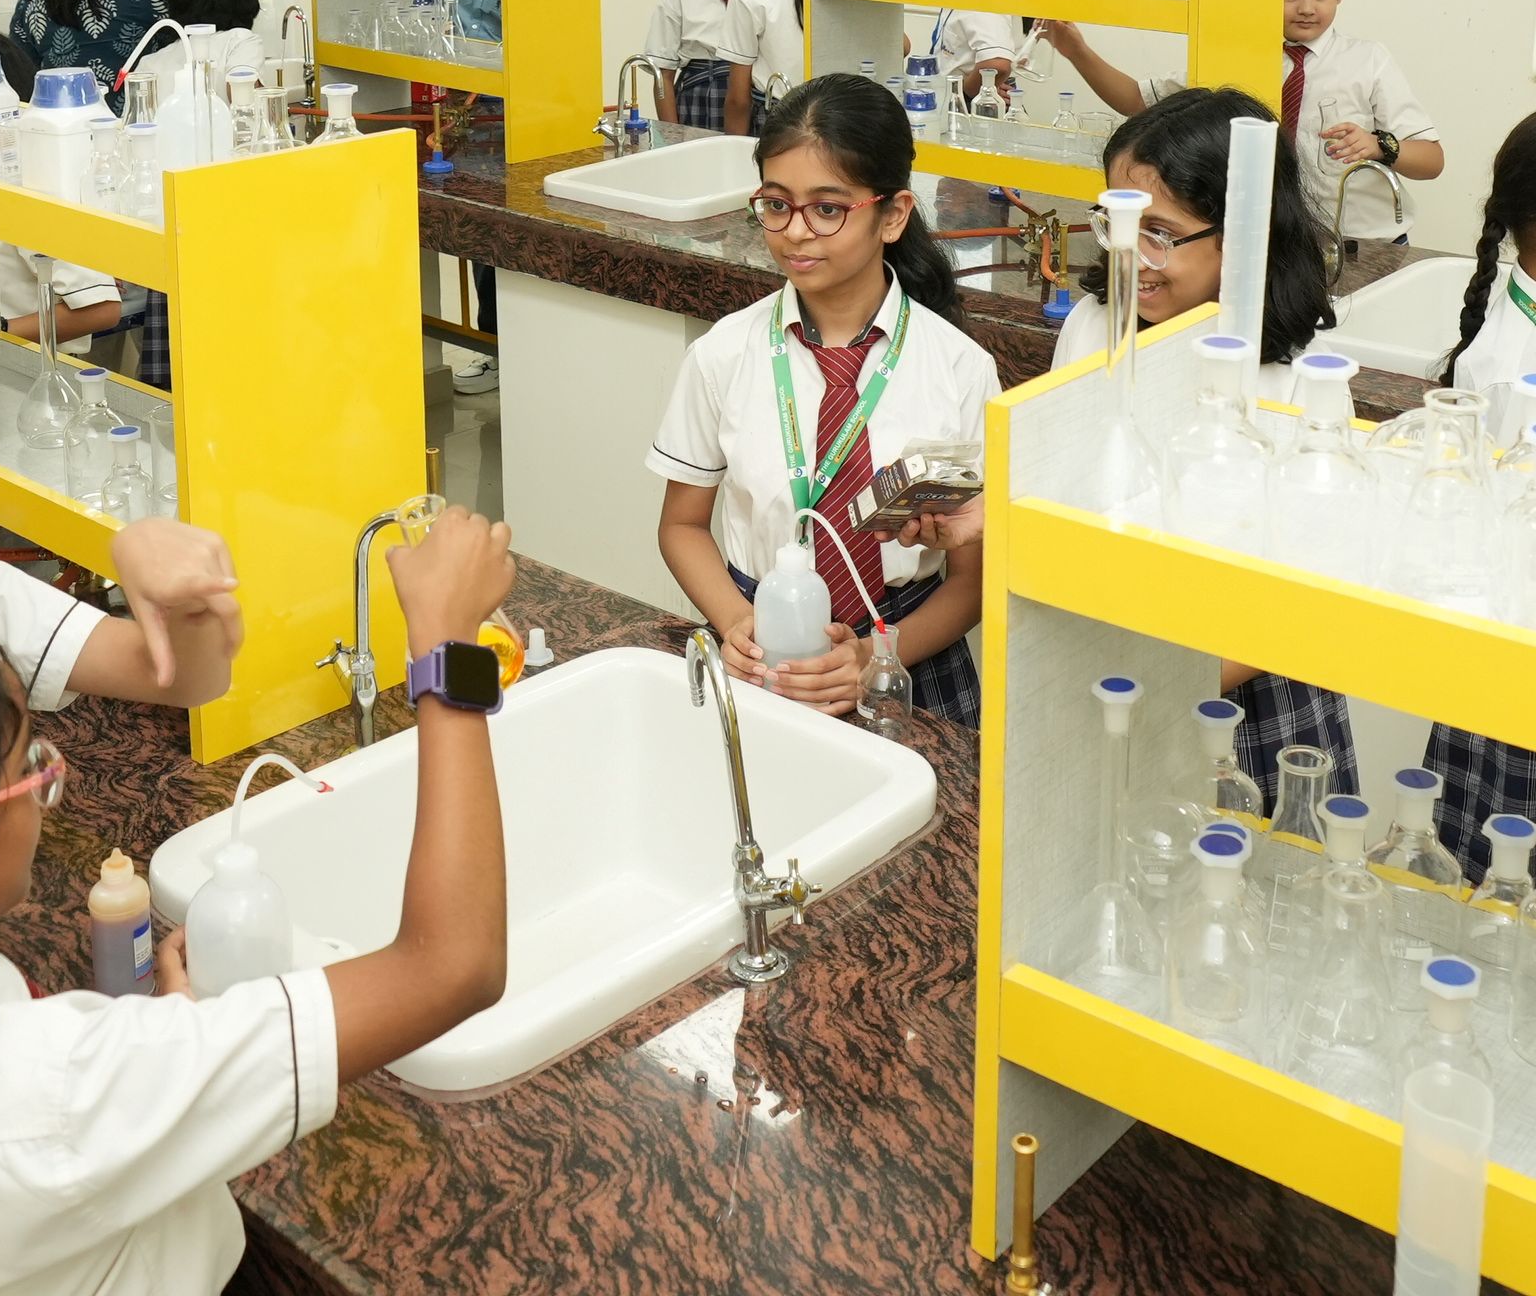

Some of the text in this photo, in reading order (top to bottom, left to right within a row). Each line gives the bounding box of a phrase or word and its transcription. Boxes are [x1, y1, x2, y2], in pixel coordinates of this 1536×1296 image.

[884, 353, 892, 364] THE
[778, 385, 787, 412] SCHOOL
[783, 412, 795, 454] GURUKULAM
[821, 399, 867, 472] THE GURUKULAM SCHOOL
